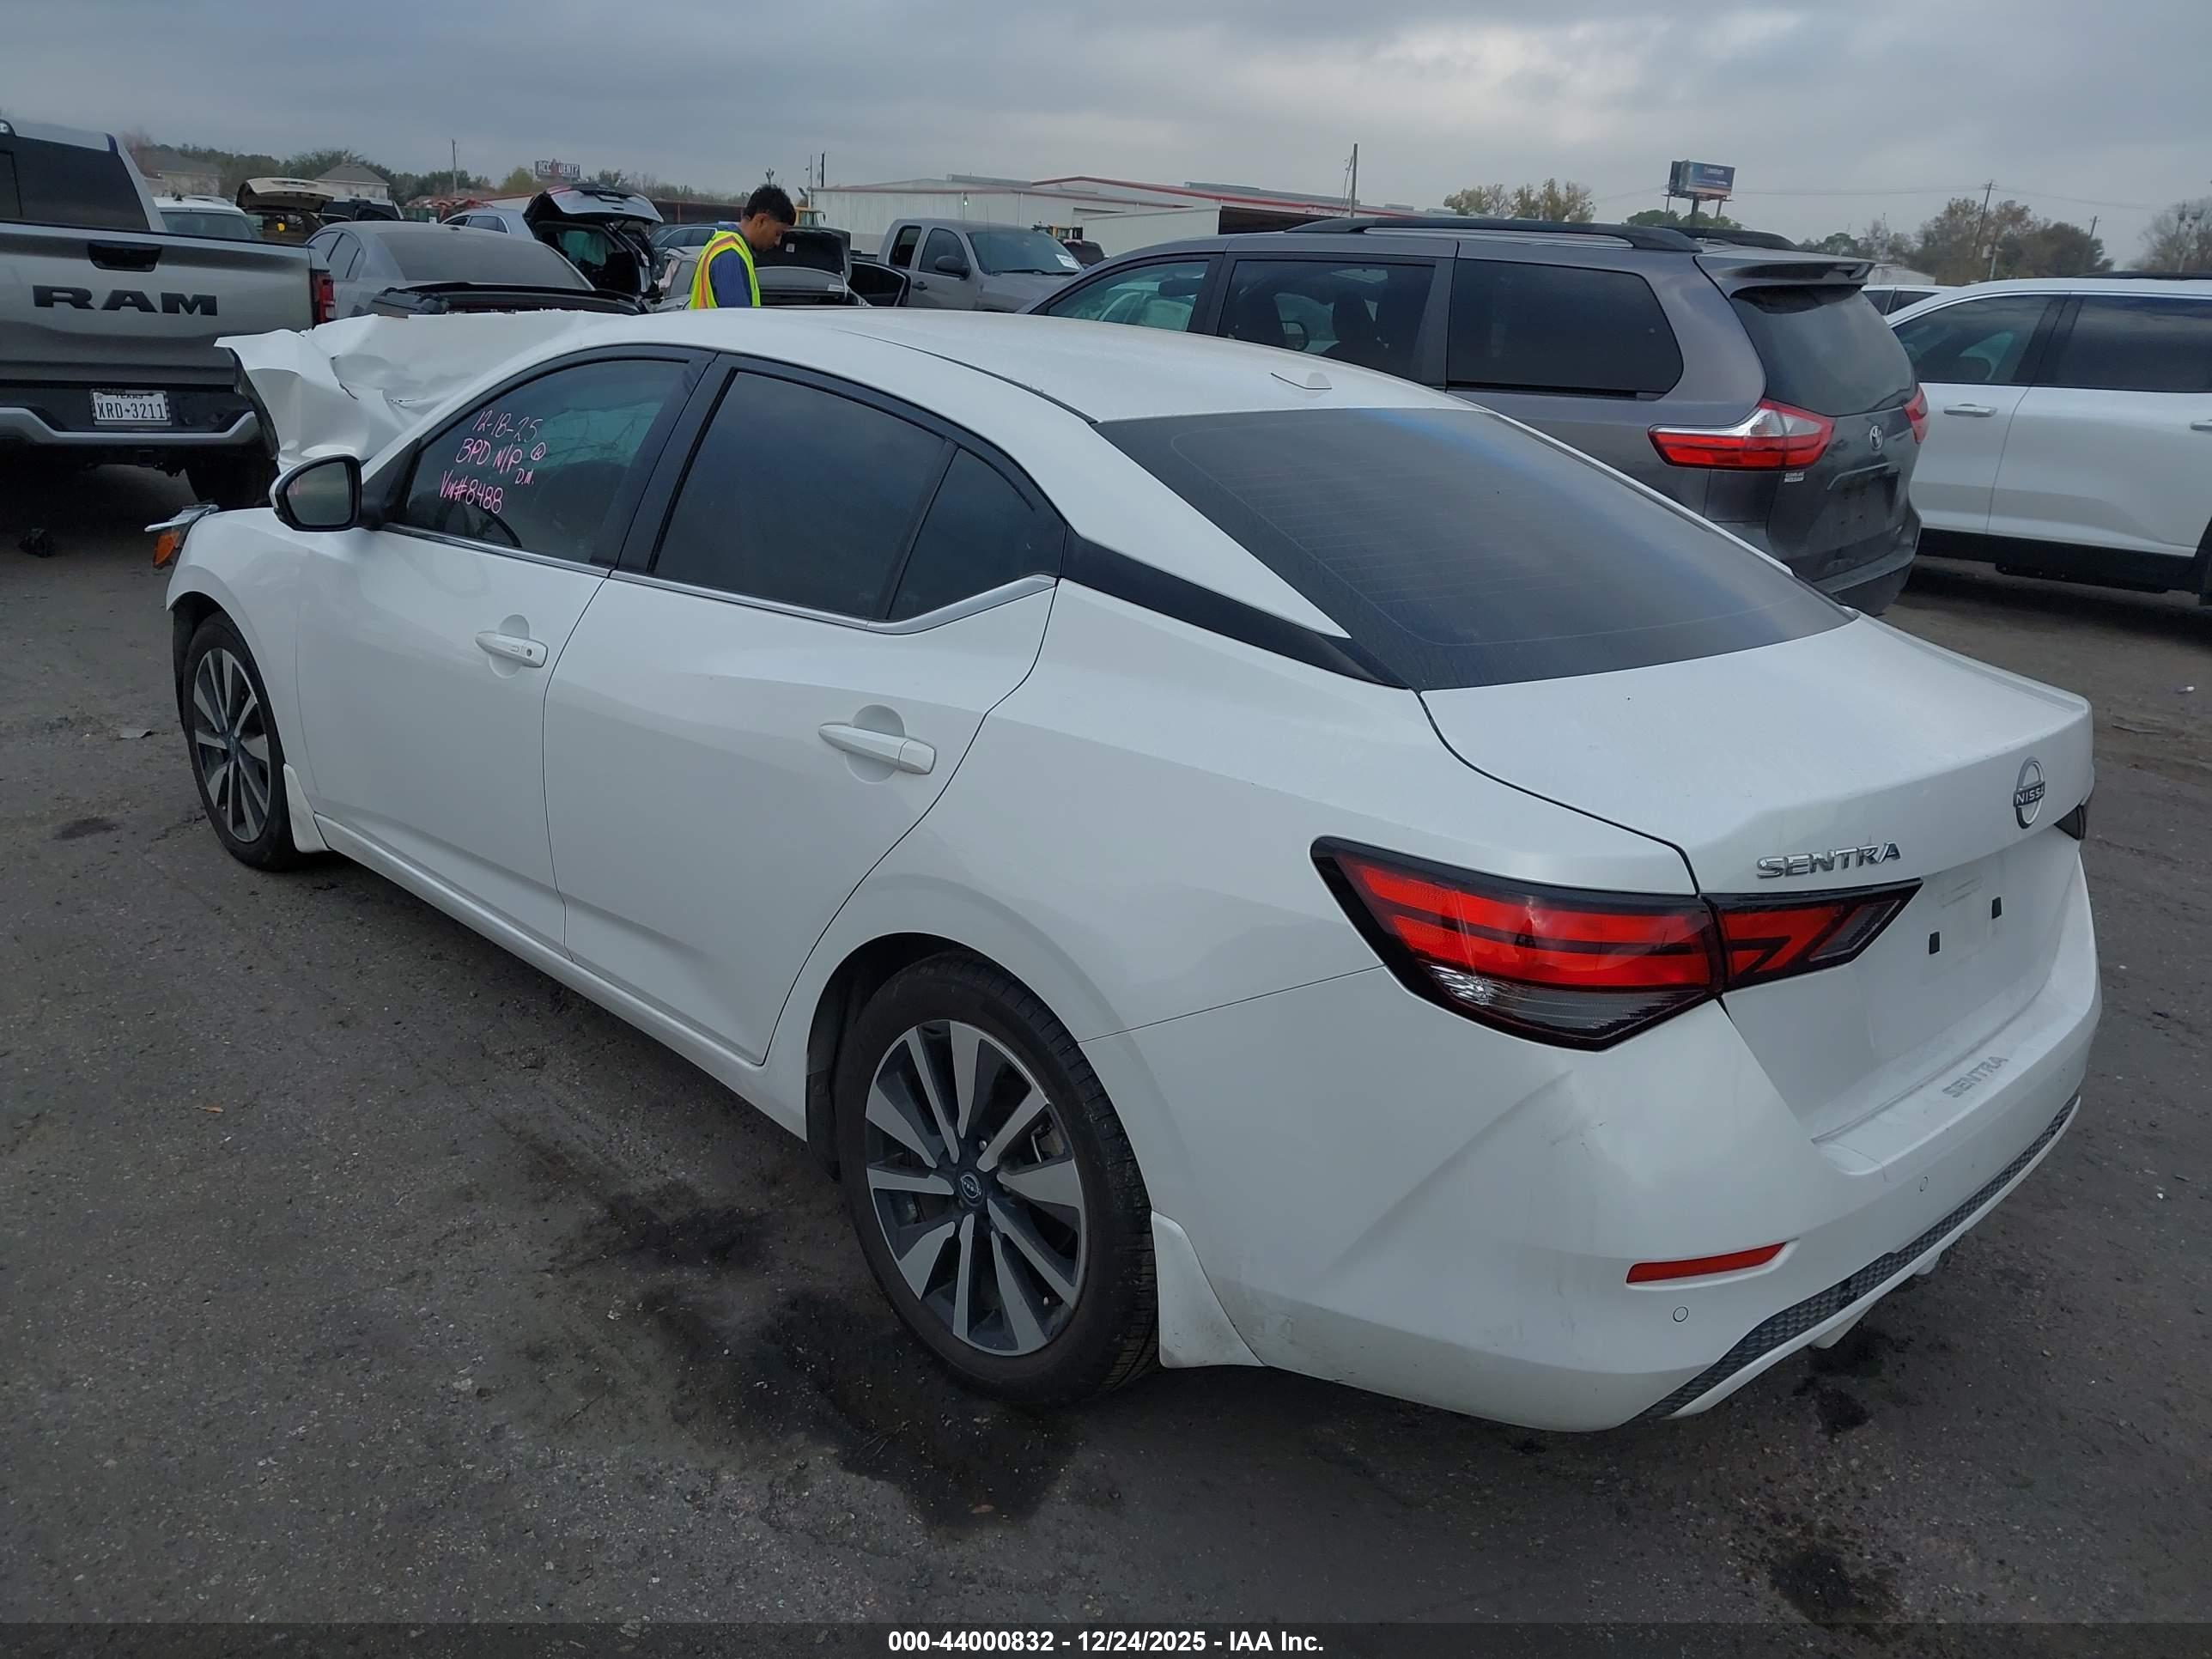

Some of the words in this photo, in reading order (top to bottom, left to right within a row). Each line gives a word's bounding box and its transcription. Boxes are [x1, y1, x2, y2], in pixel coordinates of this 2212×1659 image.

[33, 285, 217, 316] RAM
[455, 438, 491, 465] BPD
[1757, 841, 1901, 878] SENTRA
[1942, 1056, 2008, 1098] SENTRA
